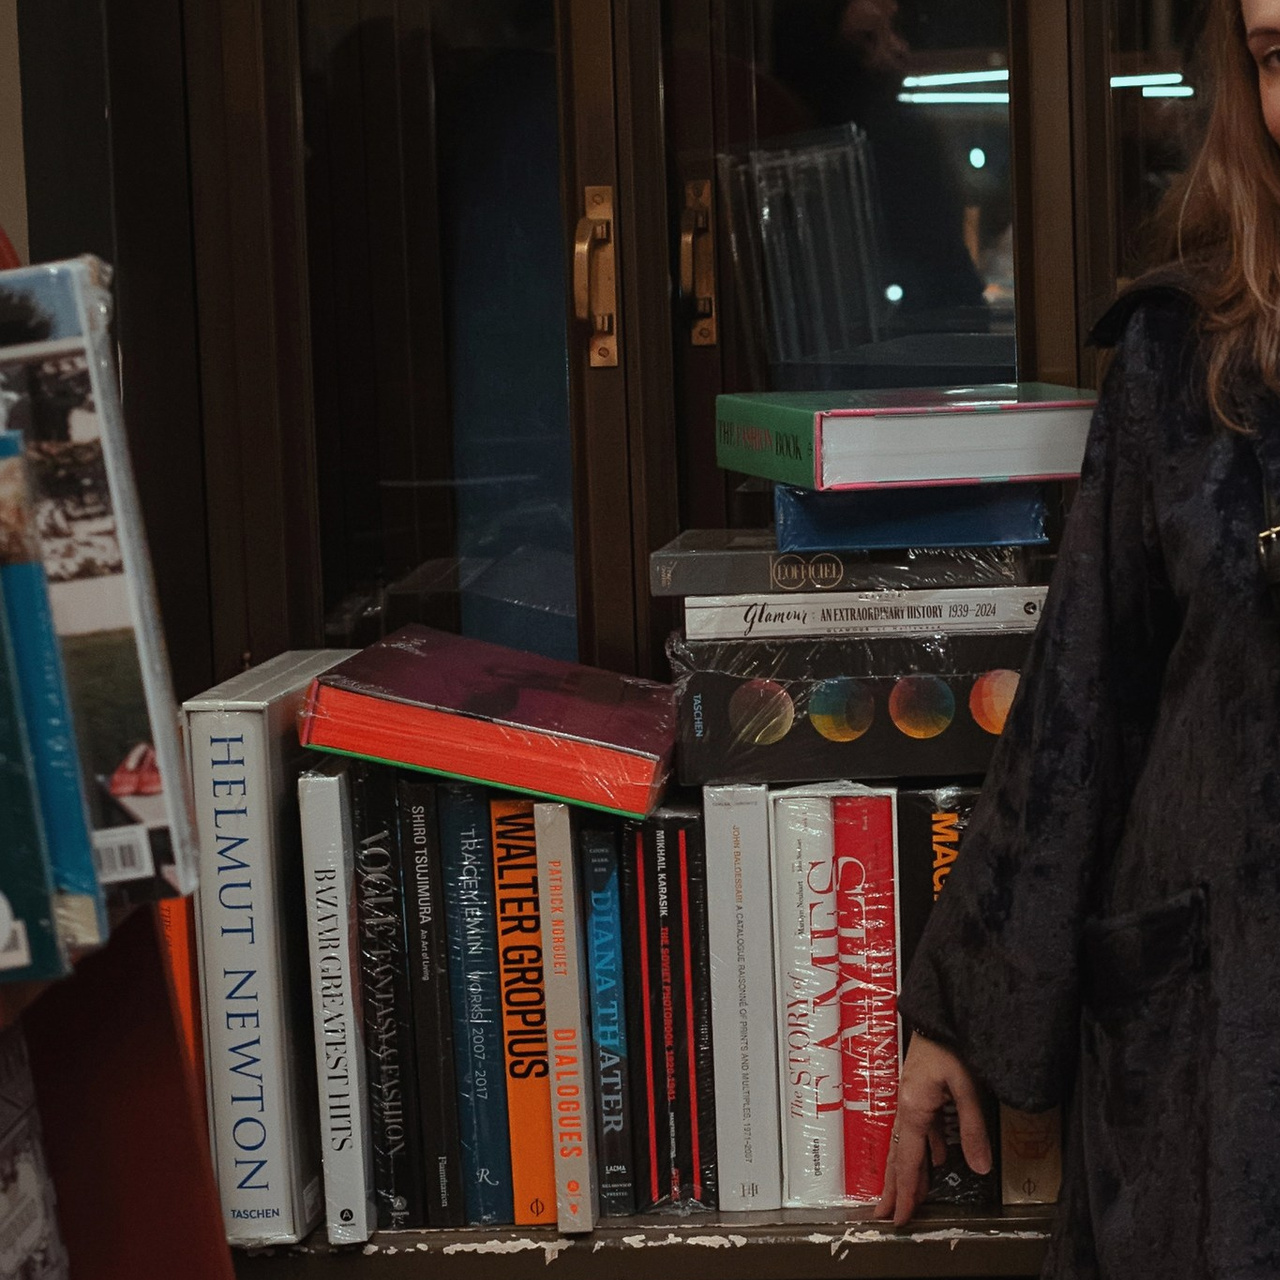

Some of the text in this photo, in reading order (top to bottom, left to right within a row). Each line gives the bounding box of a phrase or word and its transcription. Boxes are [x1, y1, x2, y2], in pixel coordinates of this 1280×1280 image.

[718, 418, 802, 462] THE FASHION BOOK
[820, 608, 832, 622] AN
[833, 606, 906, 622] EXTRAORDINARY
[907, 604, 943, 620] HISTORY
[693, 693, 704, 738] TASCHEN
[412, 805, 428, 845] SHIRO
[732, 824, 742, 849] JOHN
[459, 827, 480, 901] TRACEY
[655, 830, 667, 872] MIKHAIL
[357, 828, 398, 939] VOGUE
[413, 847, 432, 925] TSUJIMURA
[658, 873, 669, 917] KARASIK
[733, 851, 744, 904] BALDESSARI
[464, 906, 484, 955] EMIN
[548, 860, 567, 977] PATRICK NORGUET
[660, 927, 671, 945] THE
[736, 912, 747, 962] CATALOGUE
[208, 732, 270, 1192] HELMUT NEWTON
[492, 811, 551, 1081] WALTER GROPIUS
[661, 946, 673, 984] SOVIET
[369, 947, 395, 1041] FANTASY
[421, 962, 432, 982] Living
[738, 965, 749, 1007] RAISONNÉ
[807, 855, 872, 1120] EAMES
[313, 867, 354, 1152] BAZAAR GREATEST HITS
[590, 889, 625, 1135] DIANA THATER
[740, 1009, 748, 1020] OF
[740, 1021, 750, 1052] PRINTS
[786, 994, 813, 1087] STORY
[741, 1053, 750, 1071] AND
[380, 1063, 406, 1157] FASHION
[553, 1028, 583, 1159] DIALOGUES
[790, 1091, 805, 1119] The
[811, 1138, 822, 1176] gestalten
[438, 1156, 451, 1208] Flammarion
[230, 1207, 280, 1221] TASCHEN
